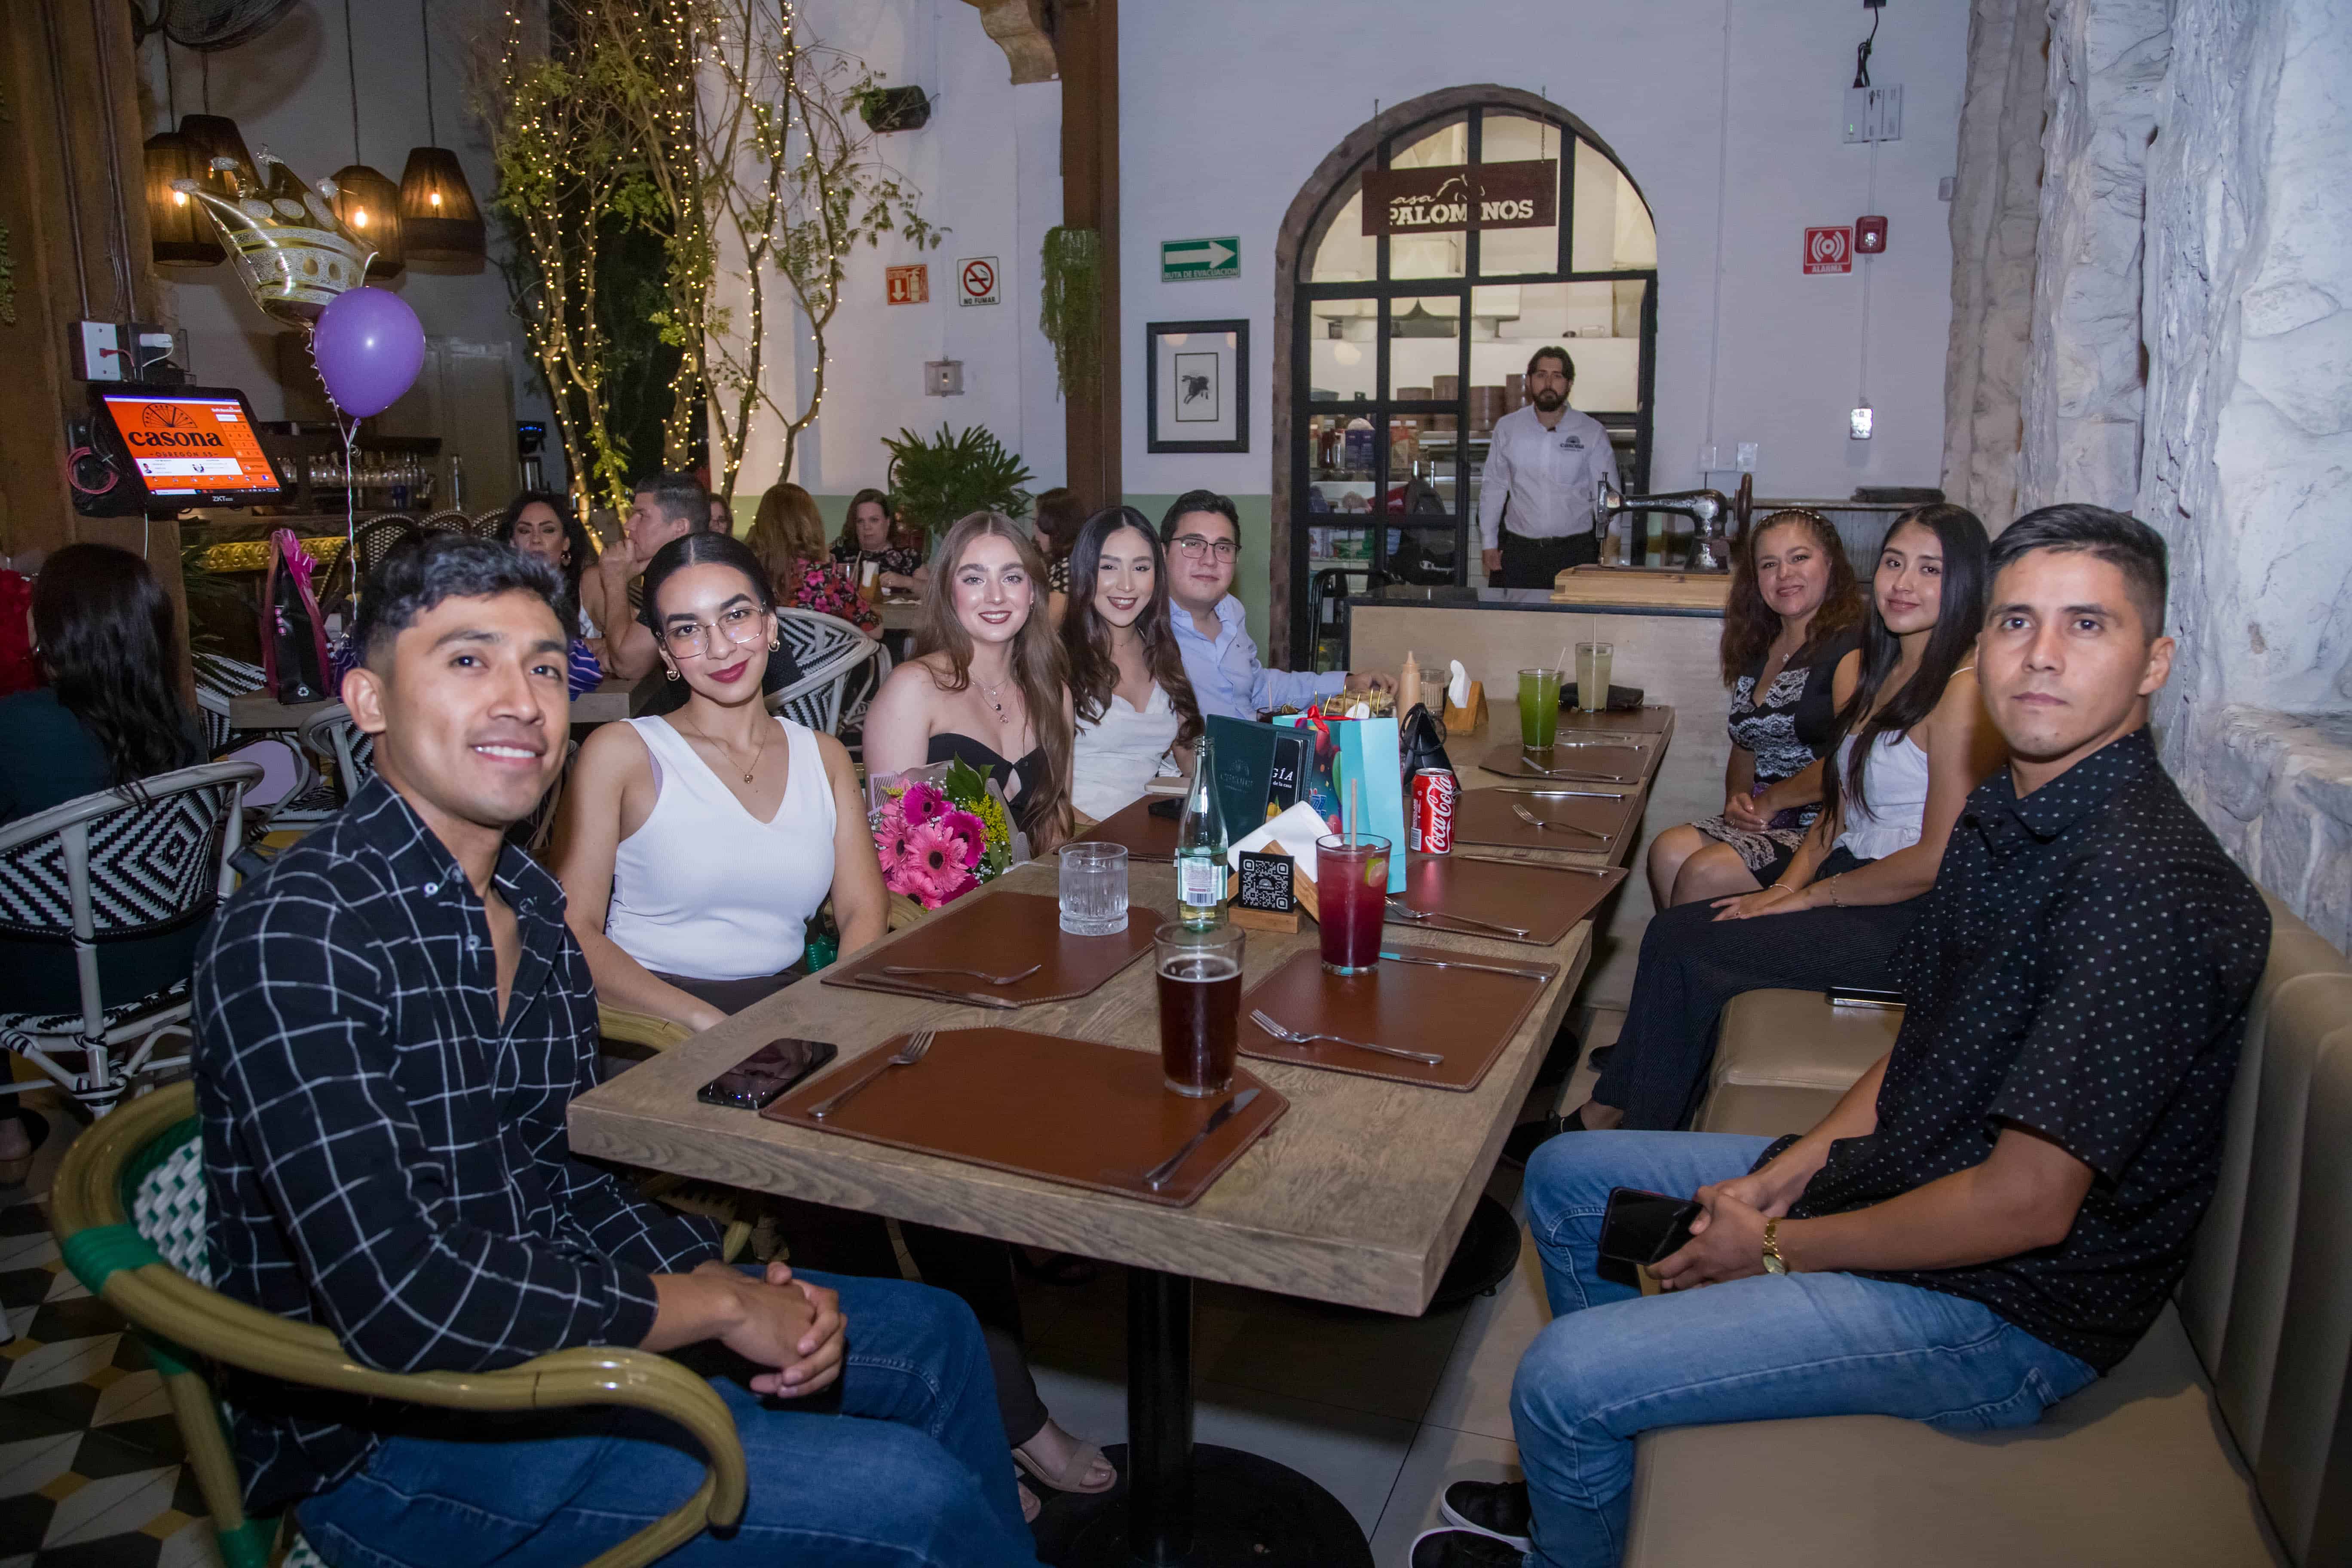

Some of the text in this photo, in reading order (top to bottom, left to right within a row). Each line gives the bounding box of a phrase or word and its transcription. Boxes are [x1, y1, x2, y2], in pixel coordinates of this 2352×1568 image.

[1390, 195, 1436, 205] asa
[1390, 199, 1534, 225] PALOMNOS
[1812, 264, 1843, 273] ALARMA
[129, 431, 225, 447] casona
[1272, 768, 1293, 781] GÍA
[1425, 776, 1452, 854] Coca-Cola
